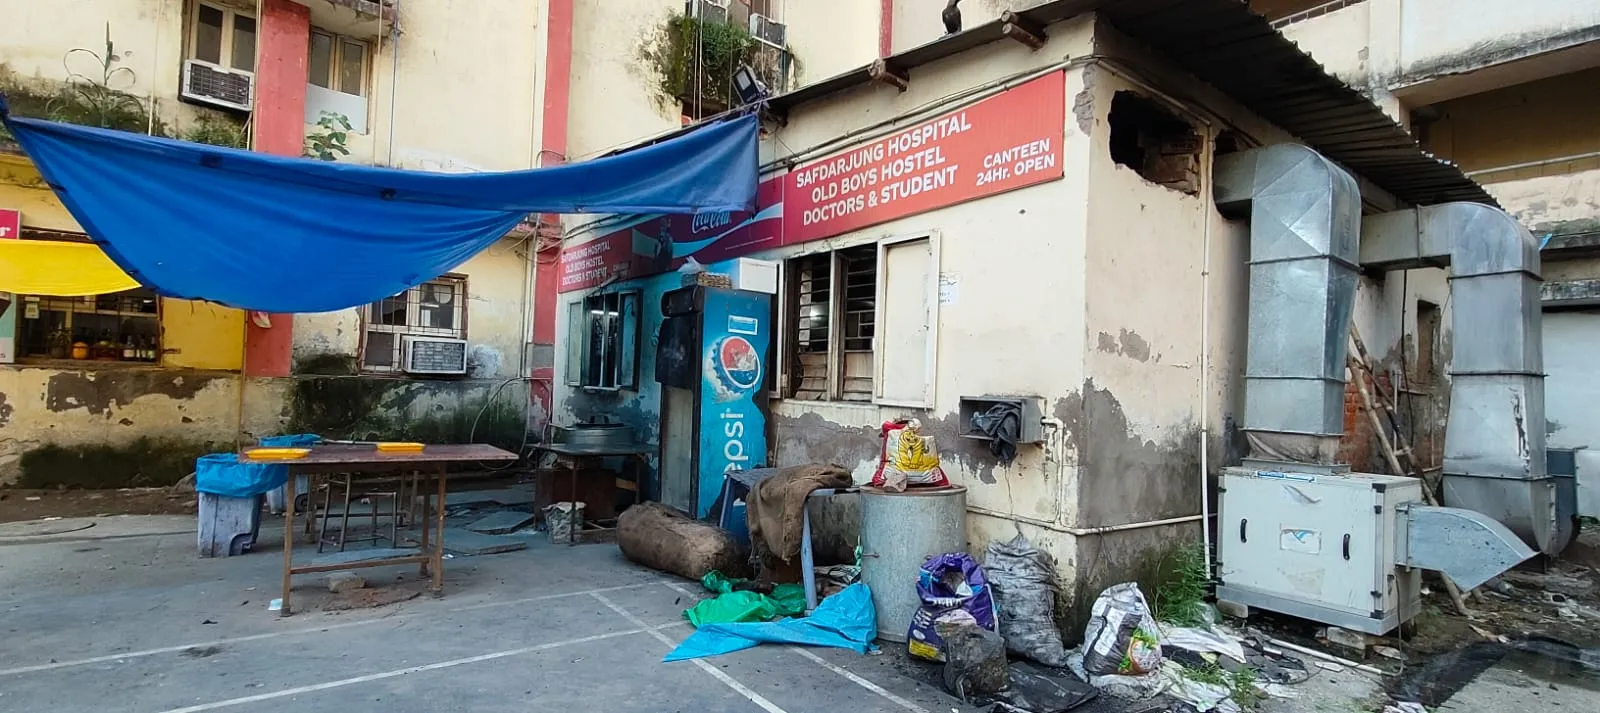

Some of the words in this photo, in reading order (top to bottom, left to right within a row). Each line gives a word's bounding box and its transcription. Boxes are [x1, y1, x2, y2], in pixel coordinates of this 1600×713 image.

[796, 143, 884, 188] SAFDARJUNG
[888, 112, 972, 157] HOSPITAL
[811, 182, 838, 203] OLD
[841, 169, 878, 194] BOYS
[881, 146, 946, 180] HOSTEL
[975, 167, 1012, 187] 24Hr.
[1014, 153, 1055, 177] OPEN
[983, 138, 1050, 169] CANTEEN
[803, 193, 865, 226] DOCTORS
[868, 190, 878, 206] &
[881, 165, 959, 204] STUDENT
